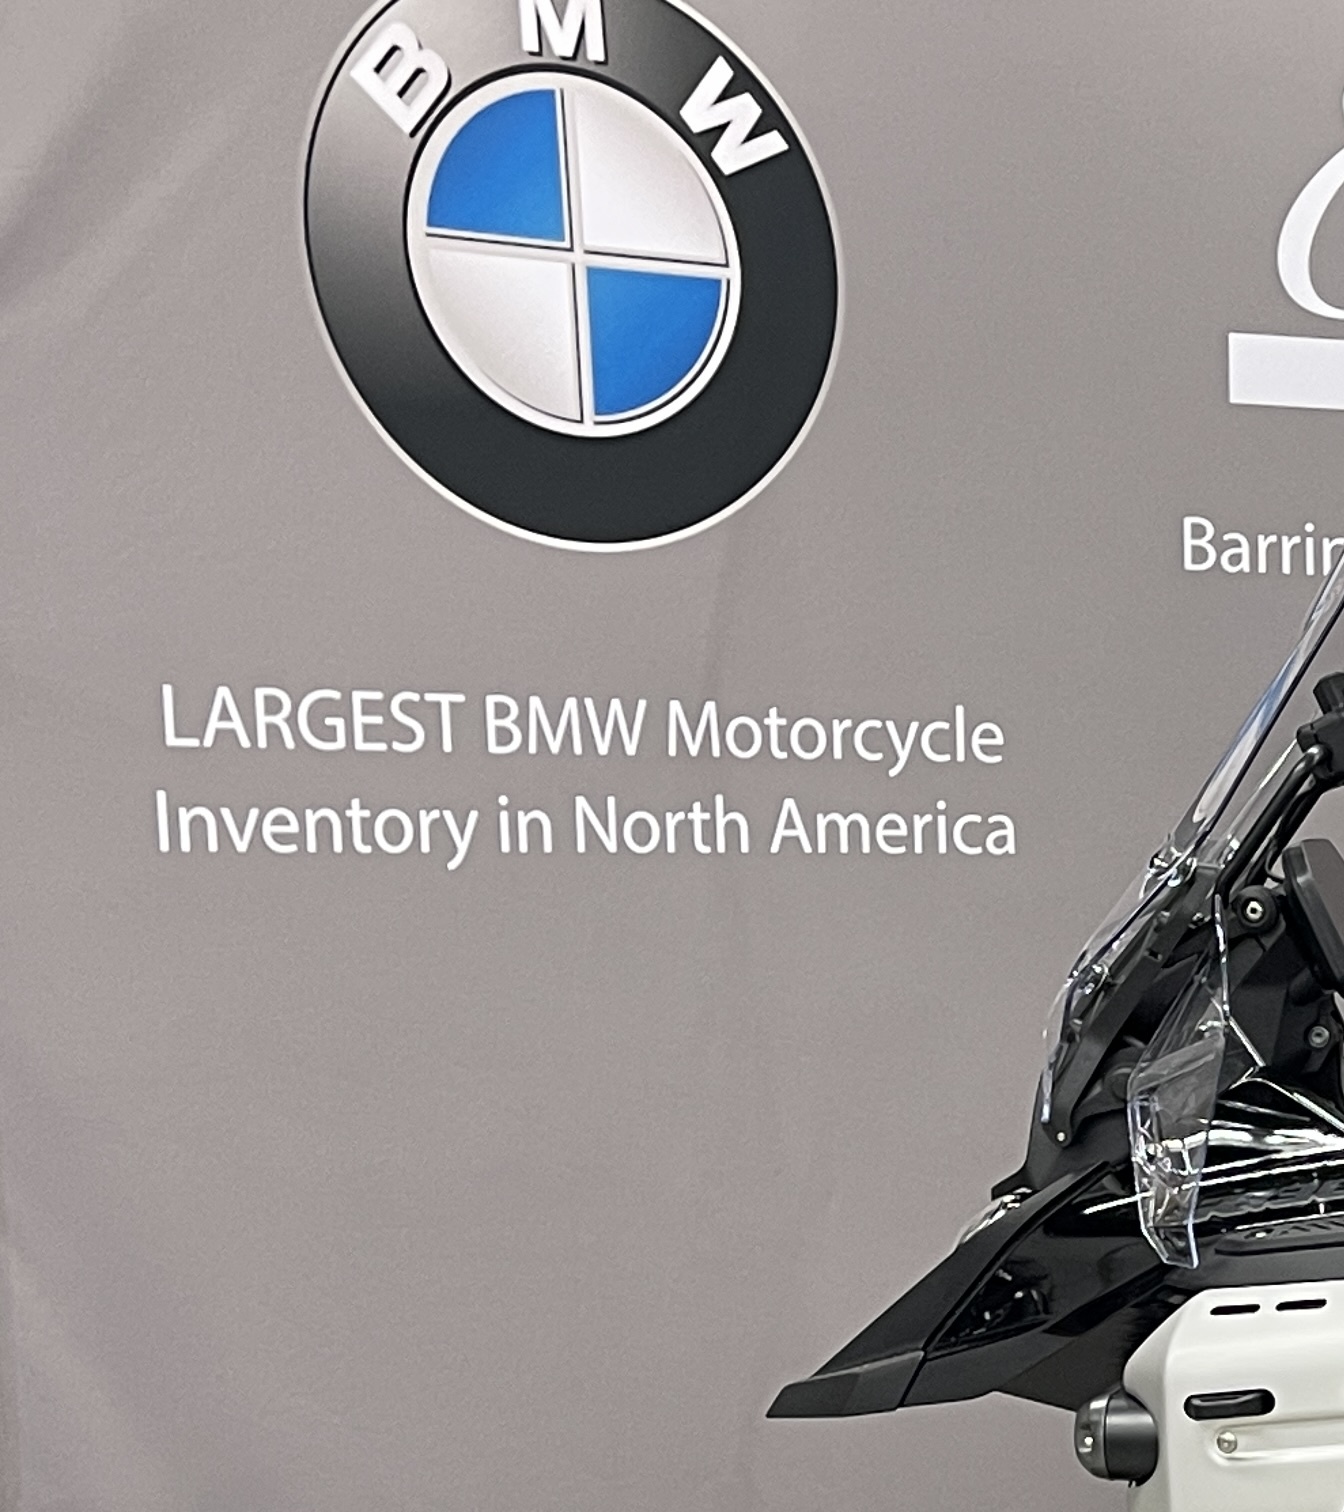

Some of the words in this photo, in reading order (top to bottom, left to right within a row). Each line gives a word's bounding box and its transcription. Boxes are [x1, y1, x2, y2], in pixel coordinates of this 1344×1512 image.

[349, 0, 790, 177] BMW
[161, 683, 467, 755] LARGEST
[484, 694, 648, 758] BMW
[667, 699, 1006, 778] Motorcycle
[155, 788, 480, 872] Inventory
[498, 794, 554, 855] in
[573, 795, 751, 855] North
[769, 797, 1017, 857] America
